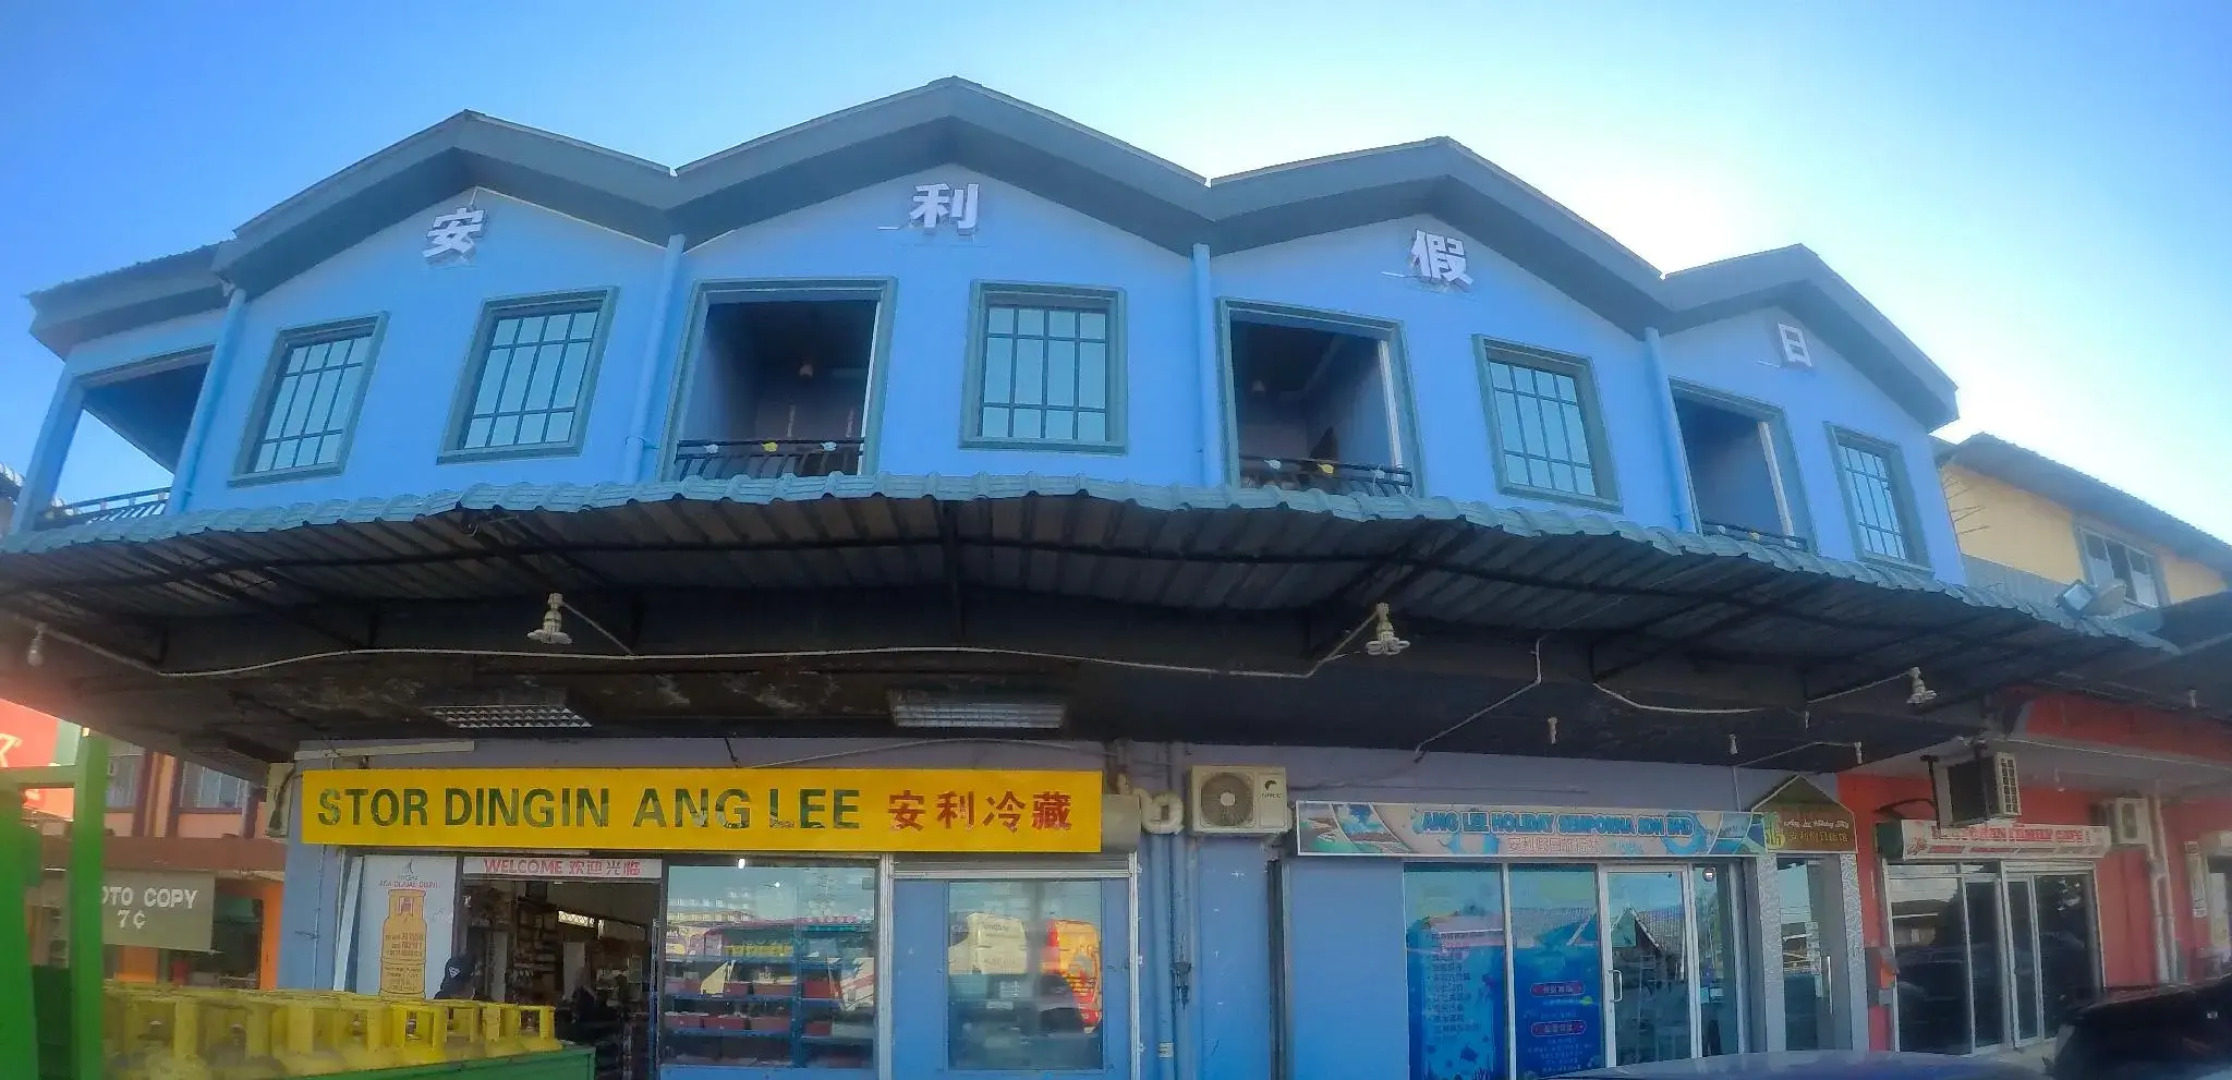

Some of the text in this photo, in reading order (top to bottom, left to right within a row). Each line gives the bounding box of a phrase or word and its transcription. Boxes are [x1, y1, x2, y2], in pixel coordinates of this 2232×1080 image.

[423, 183, 1813, 367] 安 利 假 日
[317, 787, 1073, 833] STOR DINGIN ANG LEE 安利冷藏
[1422, 811, 1460, 833] ANG
[1461, 812, 1489, 833] LEE
[1490, 812, 1555, 834] HOLIDAY
[484, 858, 564, 874] WELCOME
[101, 885, 199, 909] OTO COPY
